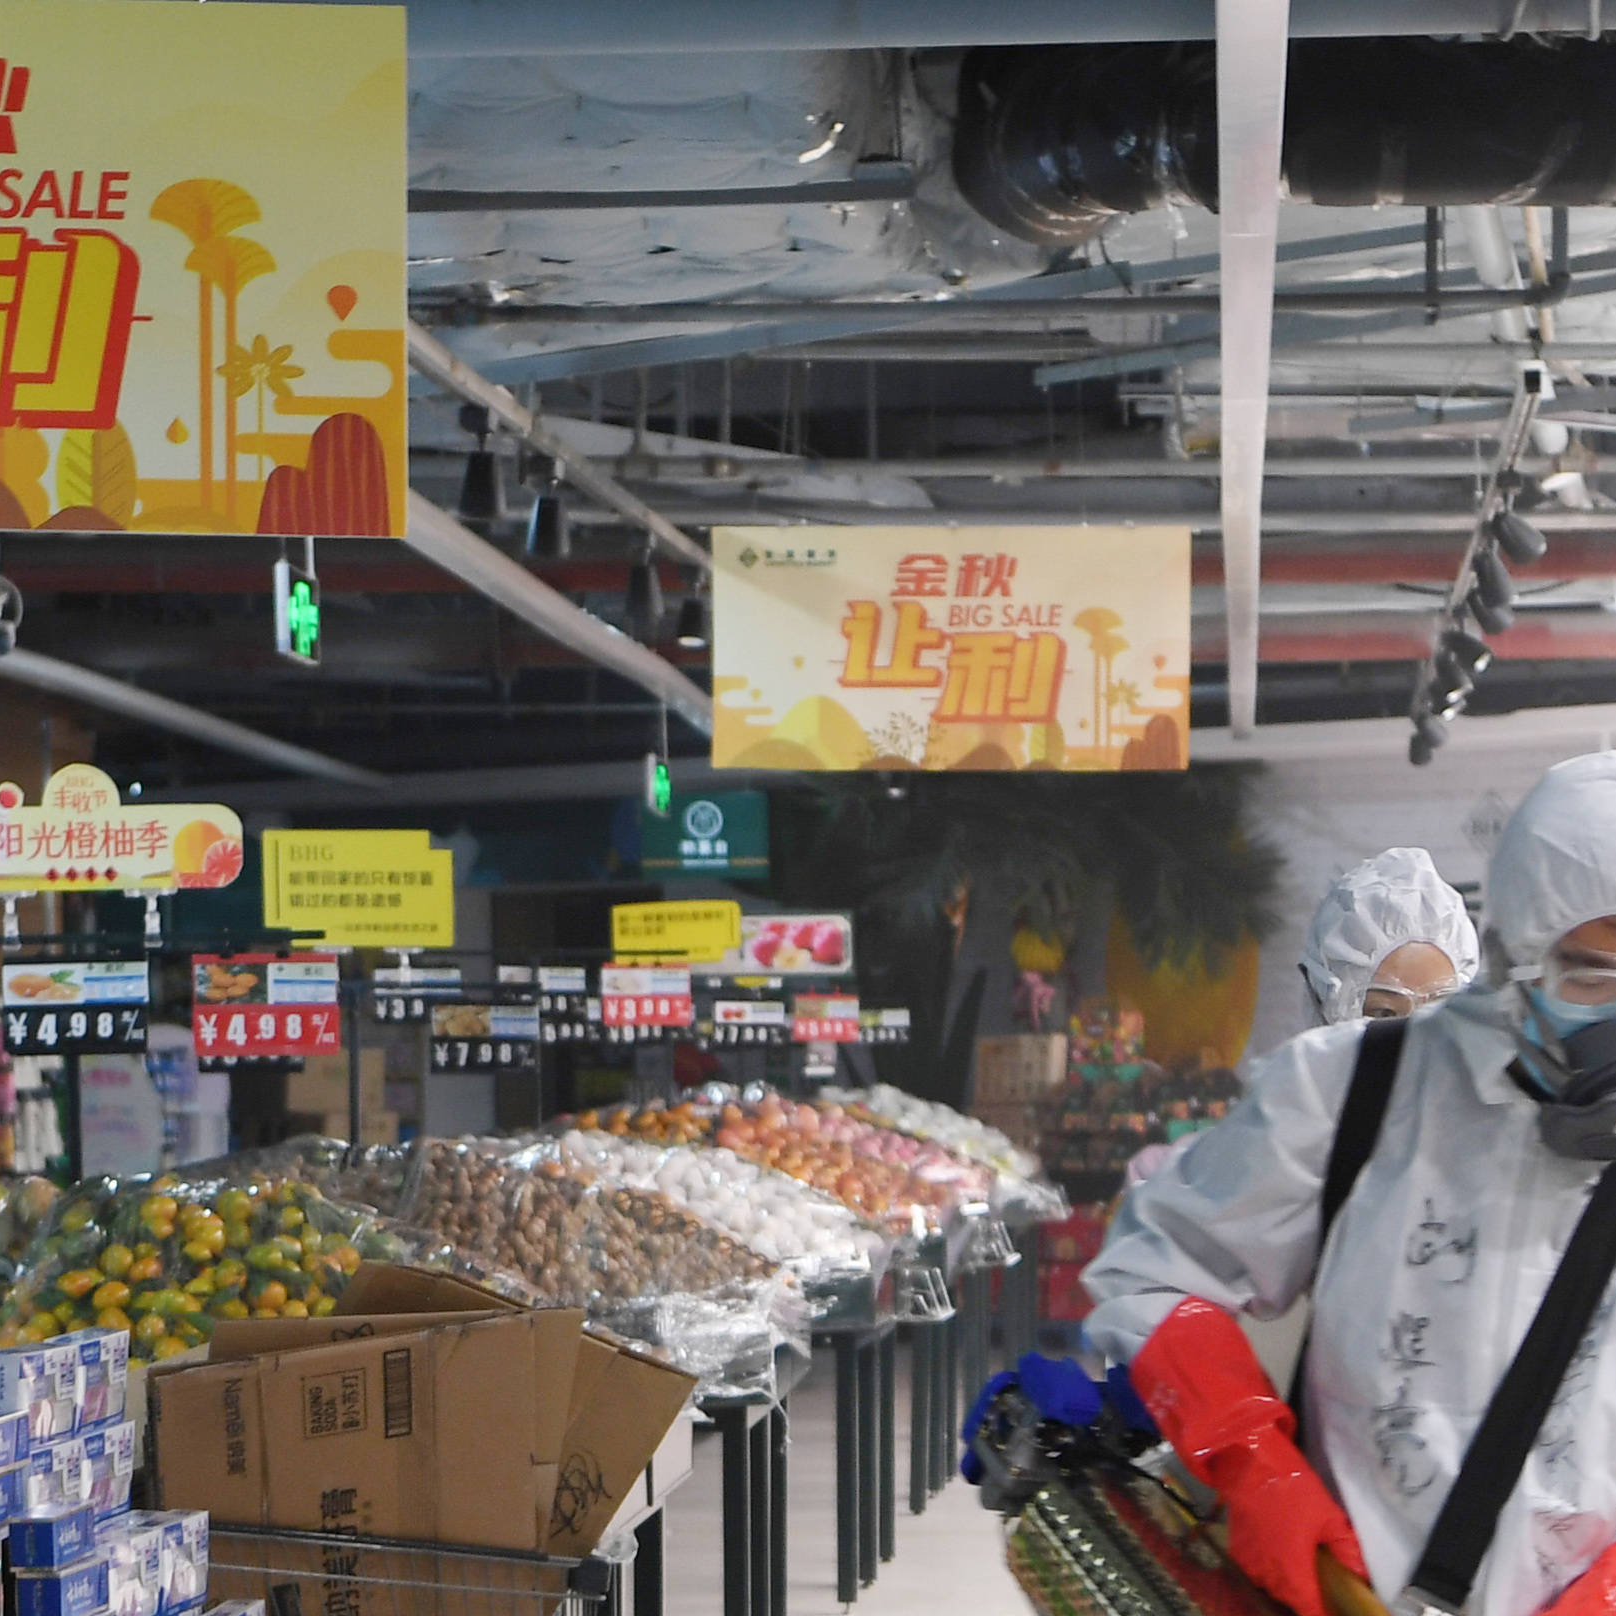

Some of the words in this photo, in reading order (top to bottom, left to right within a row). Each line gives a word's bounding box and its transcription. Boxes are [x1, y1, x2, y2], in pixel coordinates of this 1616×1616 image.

[890, 552, 1019, 599] 金秋
[948, 604, 993, 627] BIG
[1002, 604, 1064, 627] SALE
[838, 599, 1066, 725] 让利
[54, 786, 109, 814] 丰收节
[289, 845, 334, 862] BHG
[309, 1386, 323, 1435] BAKING
[323, 1397, 338, 1432] SODA
